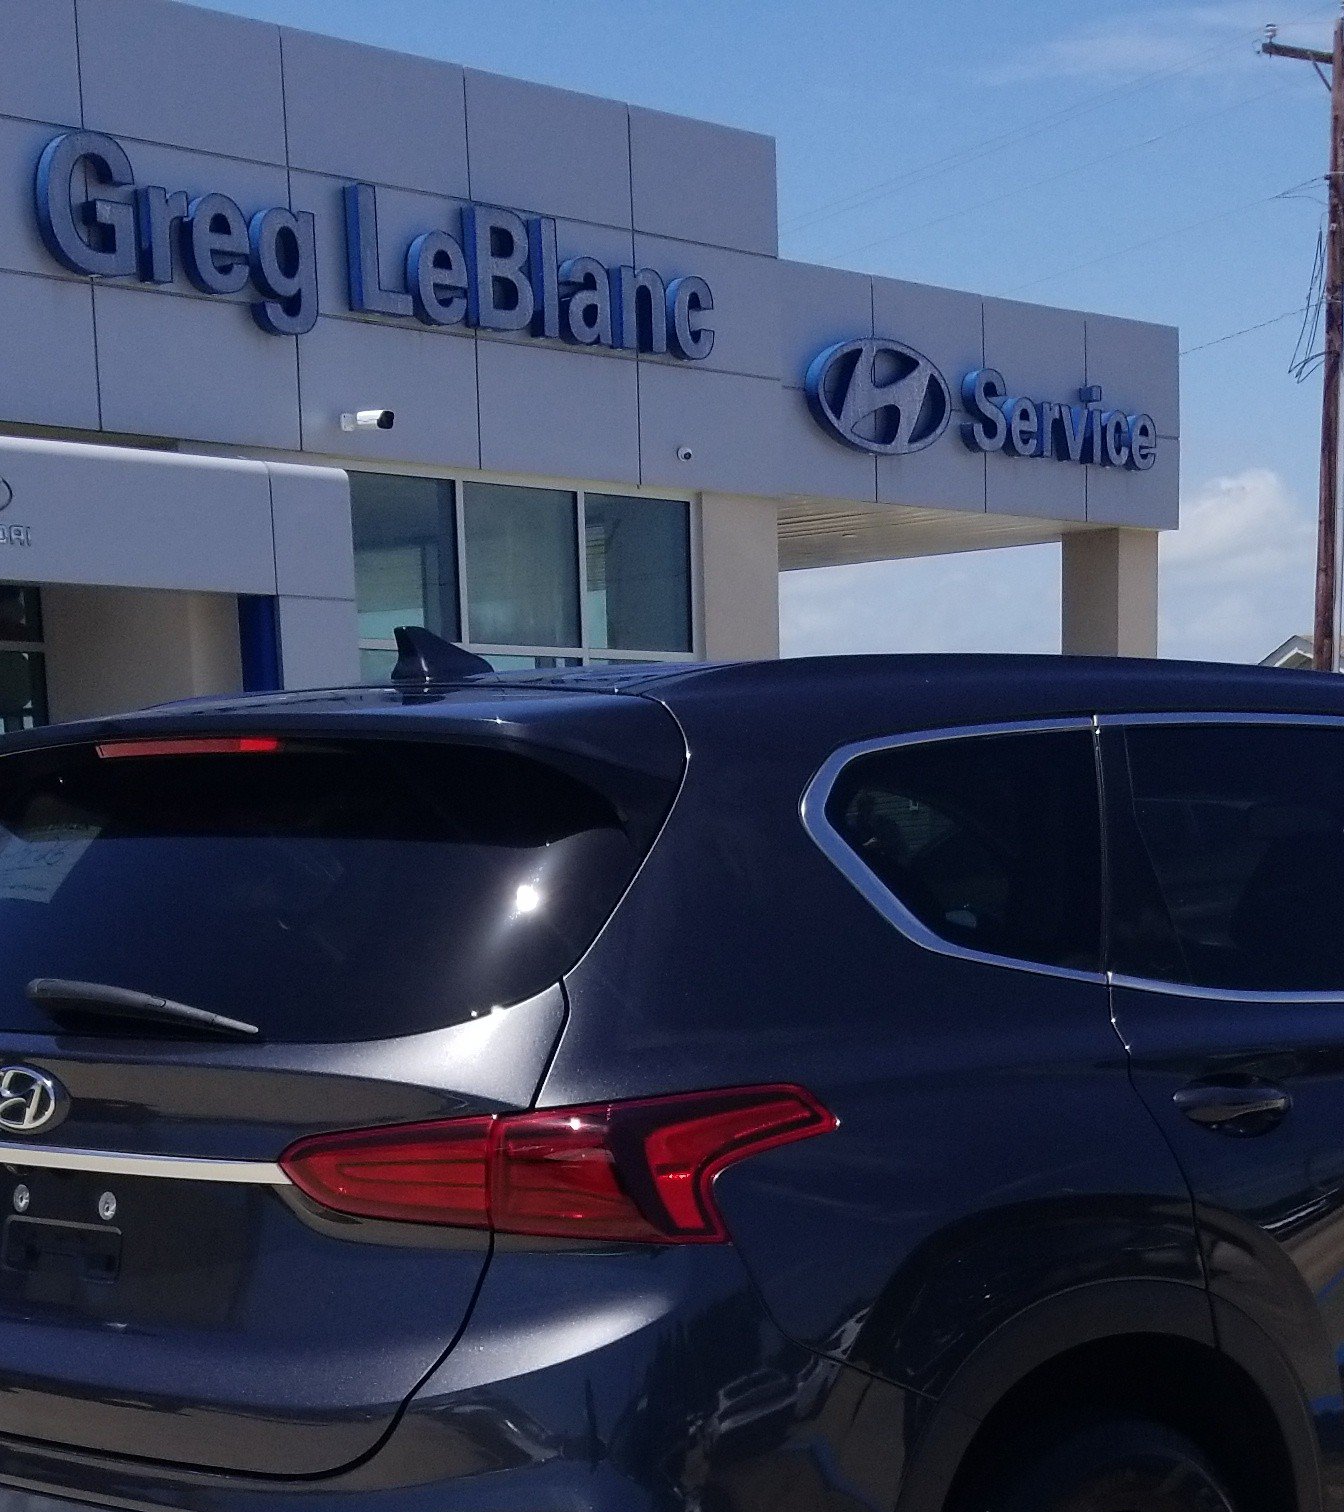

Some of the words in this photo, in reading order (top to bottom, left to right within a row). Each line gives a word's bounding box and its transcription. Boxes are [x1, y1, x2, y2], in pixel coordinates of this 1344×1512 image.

[36, 130, 319, 336] Greg
[343, 182, 716, 361] LeBlanc
[961, 368, 1157, 471] Service
